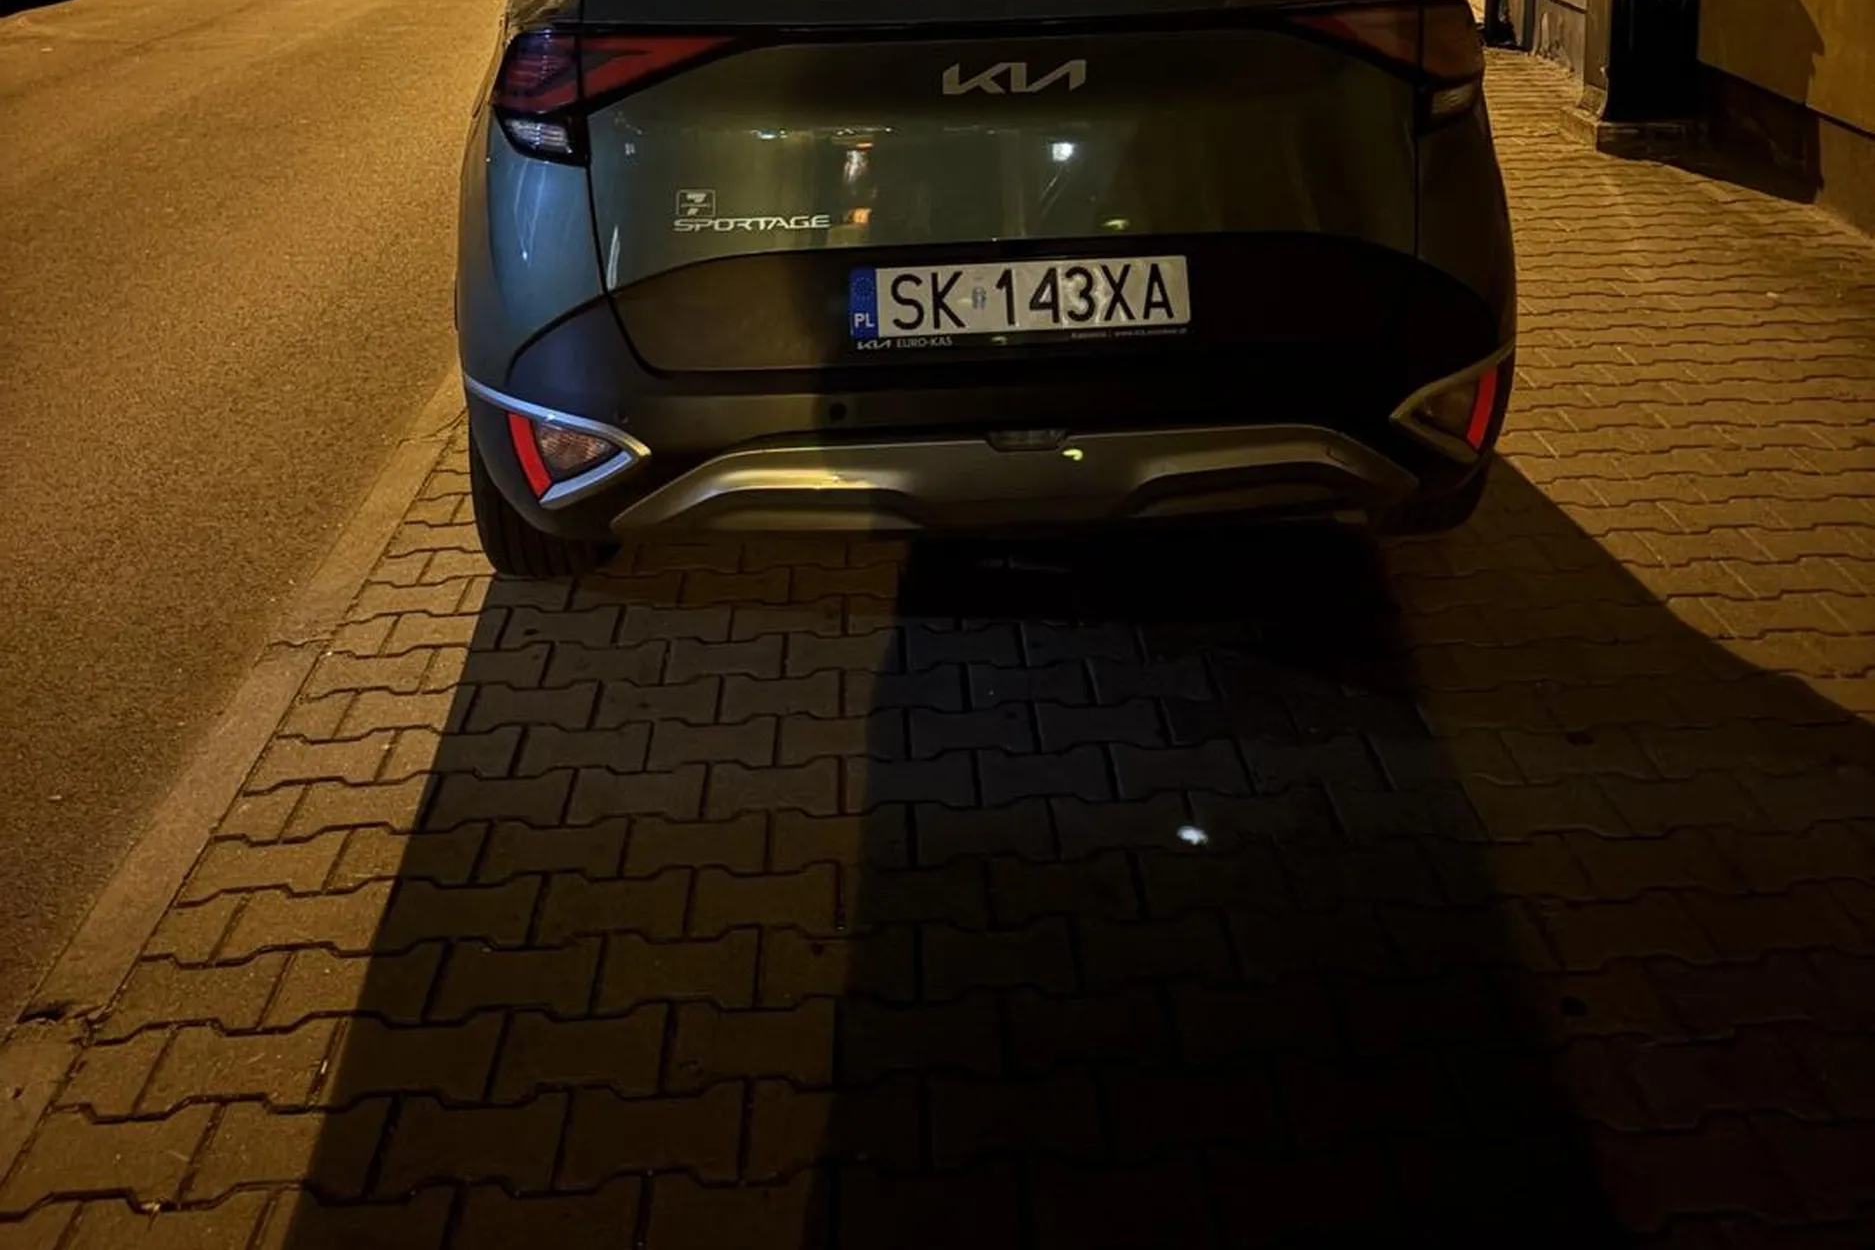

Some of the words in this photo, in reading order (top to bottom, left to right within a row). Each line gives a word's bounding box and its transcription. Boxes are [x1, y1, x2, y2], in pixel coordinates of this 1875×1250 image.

[942, 59, 1087, 96] KIA
[673, 214, 832, 232] SPORTAGE
[889, 270, 966, 331] SK
[995, 262, 1176, 327] 143XA
[854, 314, 875, 328] PL
